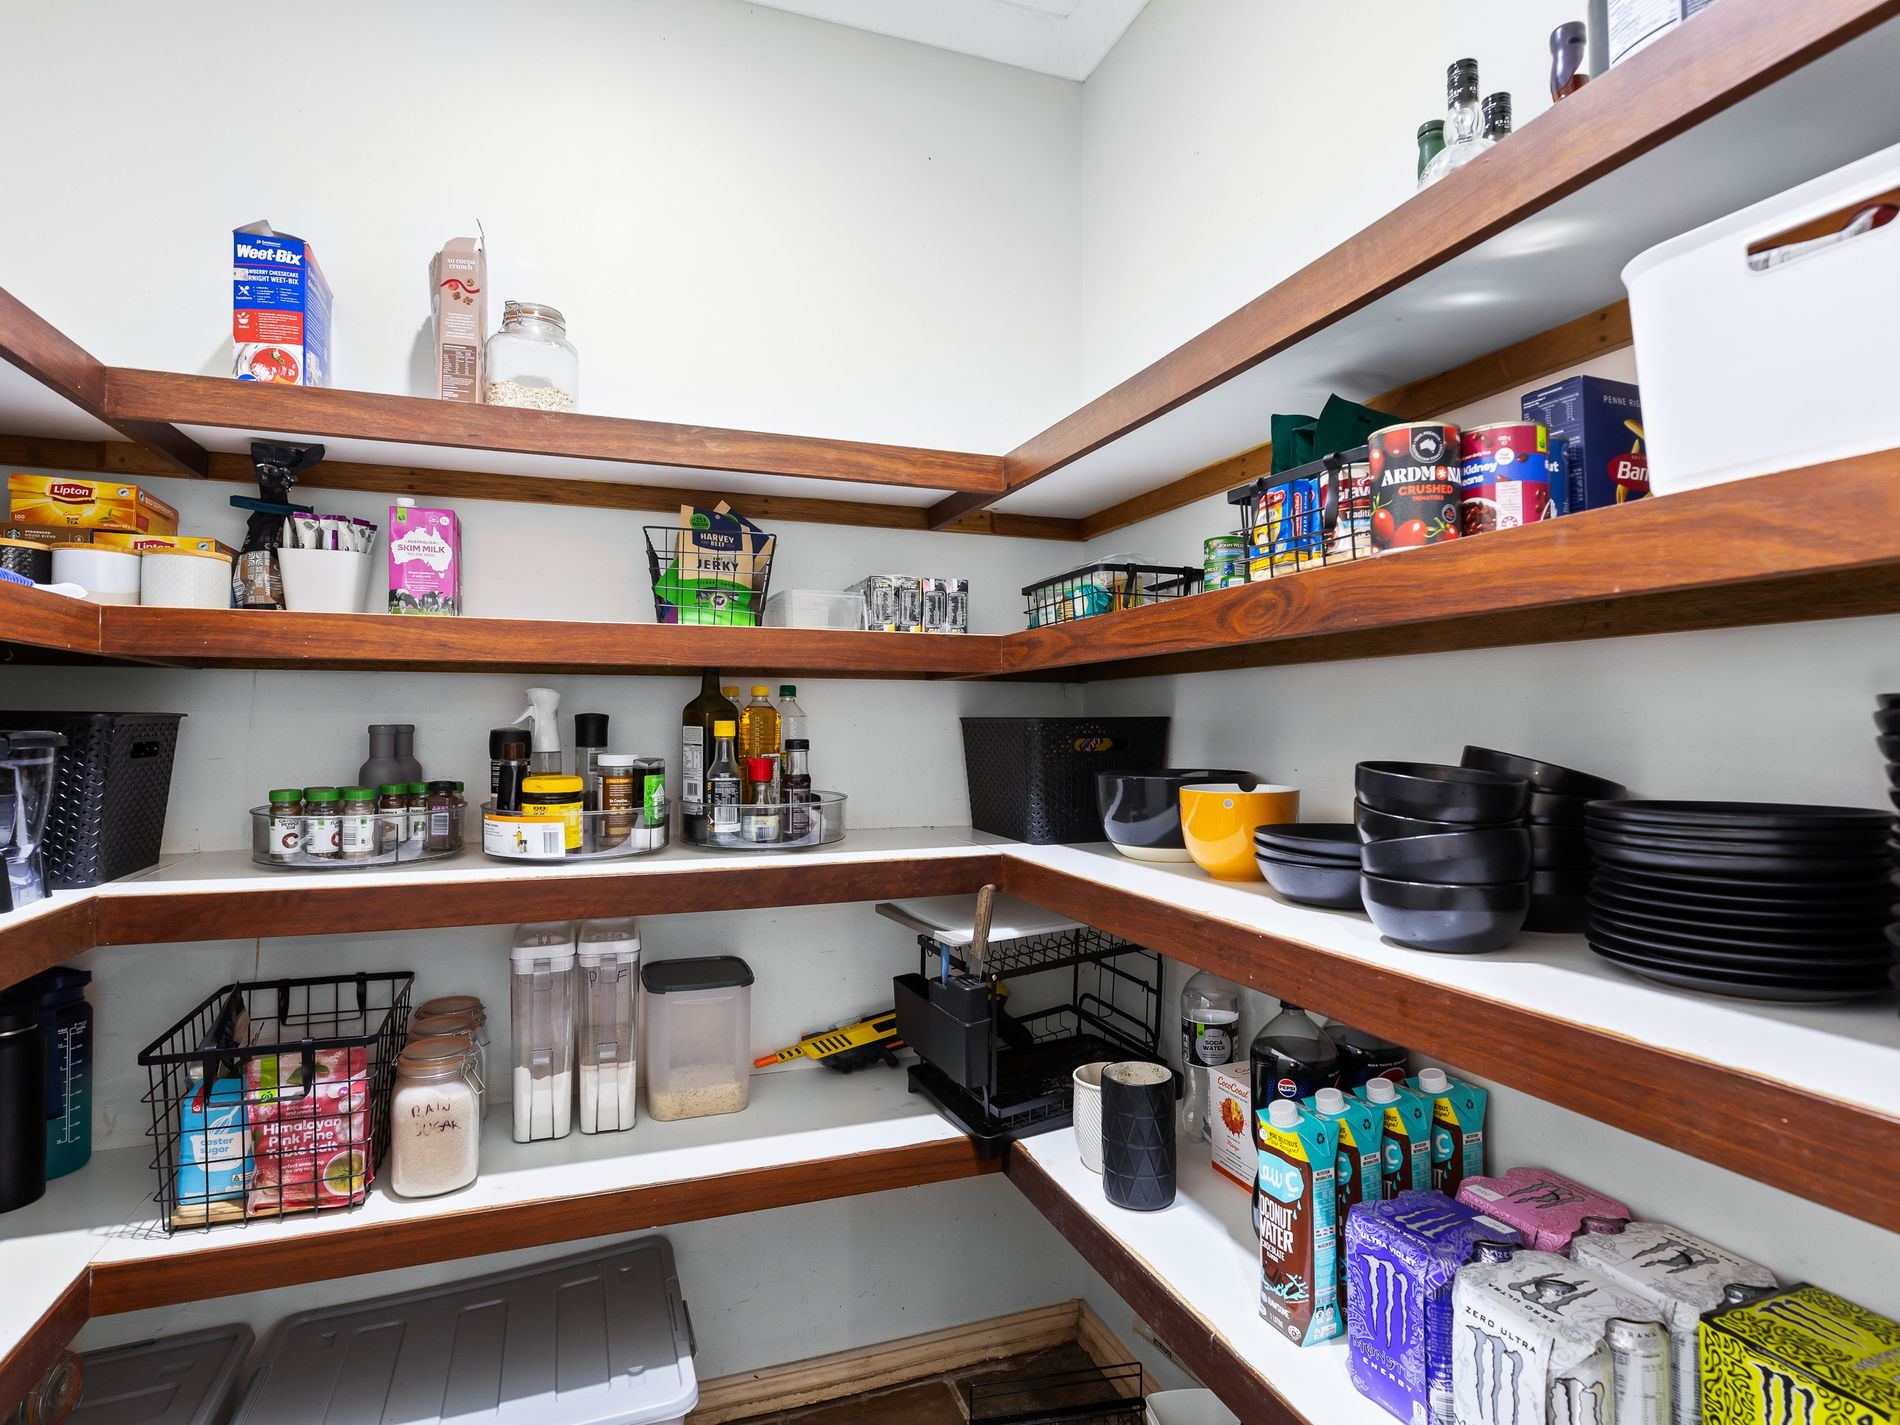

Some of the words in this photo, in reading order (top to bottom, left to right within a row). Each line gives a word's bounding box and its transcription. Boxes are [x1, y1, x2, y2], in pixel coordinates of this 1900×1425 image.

[237, 244, 303, 266] Weet-Bix
[247, 268, 268, 276] AWBERRY
[269, 269, 299, 278] CHEESECAKE
[248, 275, 269, 283] RNIGHT
[271, 276, 299, 286] WEET-BIX
[1603, 394, 1627, 406] PENNE
[1629, 399, 1641, 408] RIG
[1463, 461, 1498, 475] Kidney
[1461, 475, 1484, 486] eans
[53, 486, 90, 497] Lipton
[1398, 484, 1454, 496] CRUSHED
[1345, 510, 1371, 519] Taditi
[700, 533, 735, 543] HARVEY
[397, 543, 420, 552] SKIM
[422, 546, 445, 554] MILK
[697, 558, 738, 571] JERKY
[281, 832, 299, 849] C
[1217, 1076, 1249, 1099] CocoCoast
[263, 1118, 341, 1136] Himalayan
[200, 1137, 234, 1146] caster
[1260, 1164, 1283, 1189] aw
[1259, 1193, 1293, 1231] OCONUT
[1360, 1231, 1388, 1250] ULTRA
[1389, 1245, 1418, 1267] VIOLET
[1465, 1305, 1495, 1328] ZERO
[1500, 1327, 1537, 1355] ULTRA
[1362, 1356, 1412, 1393] ENERGY
